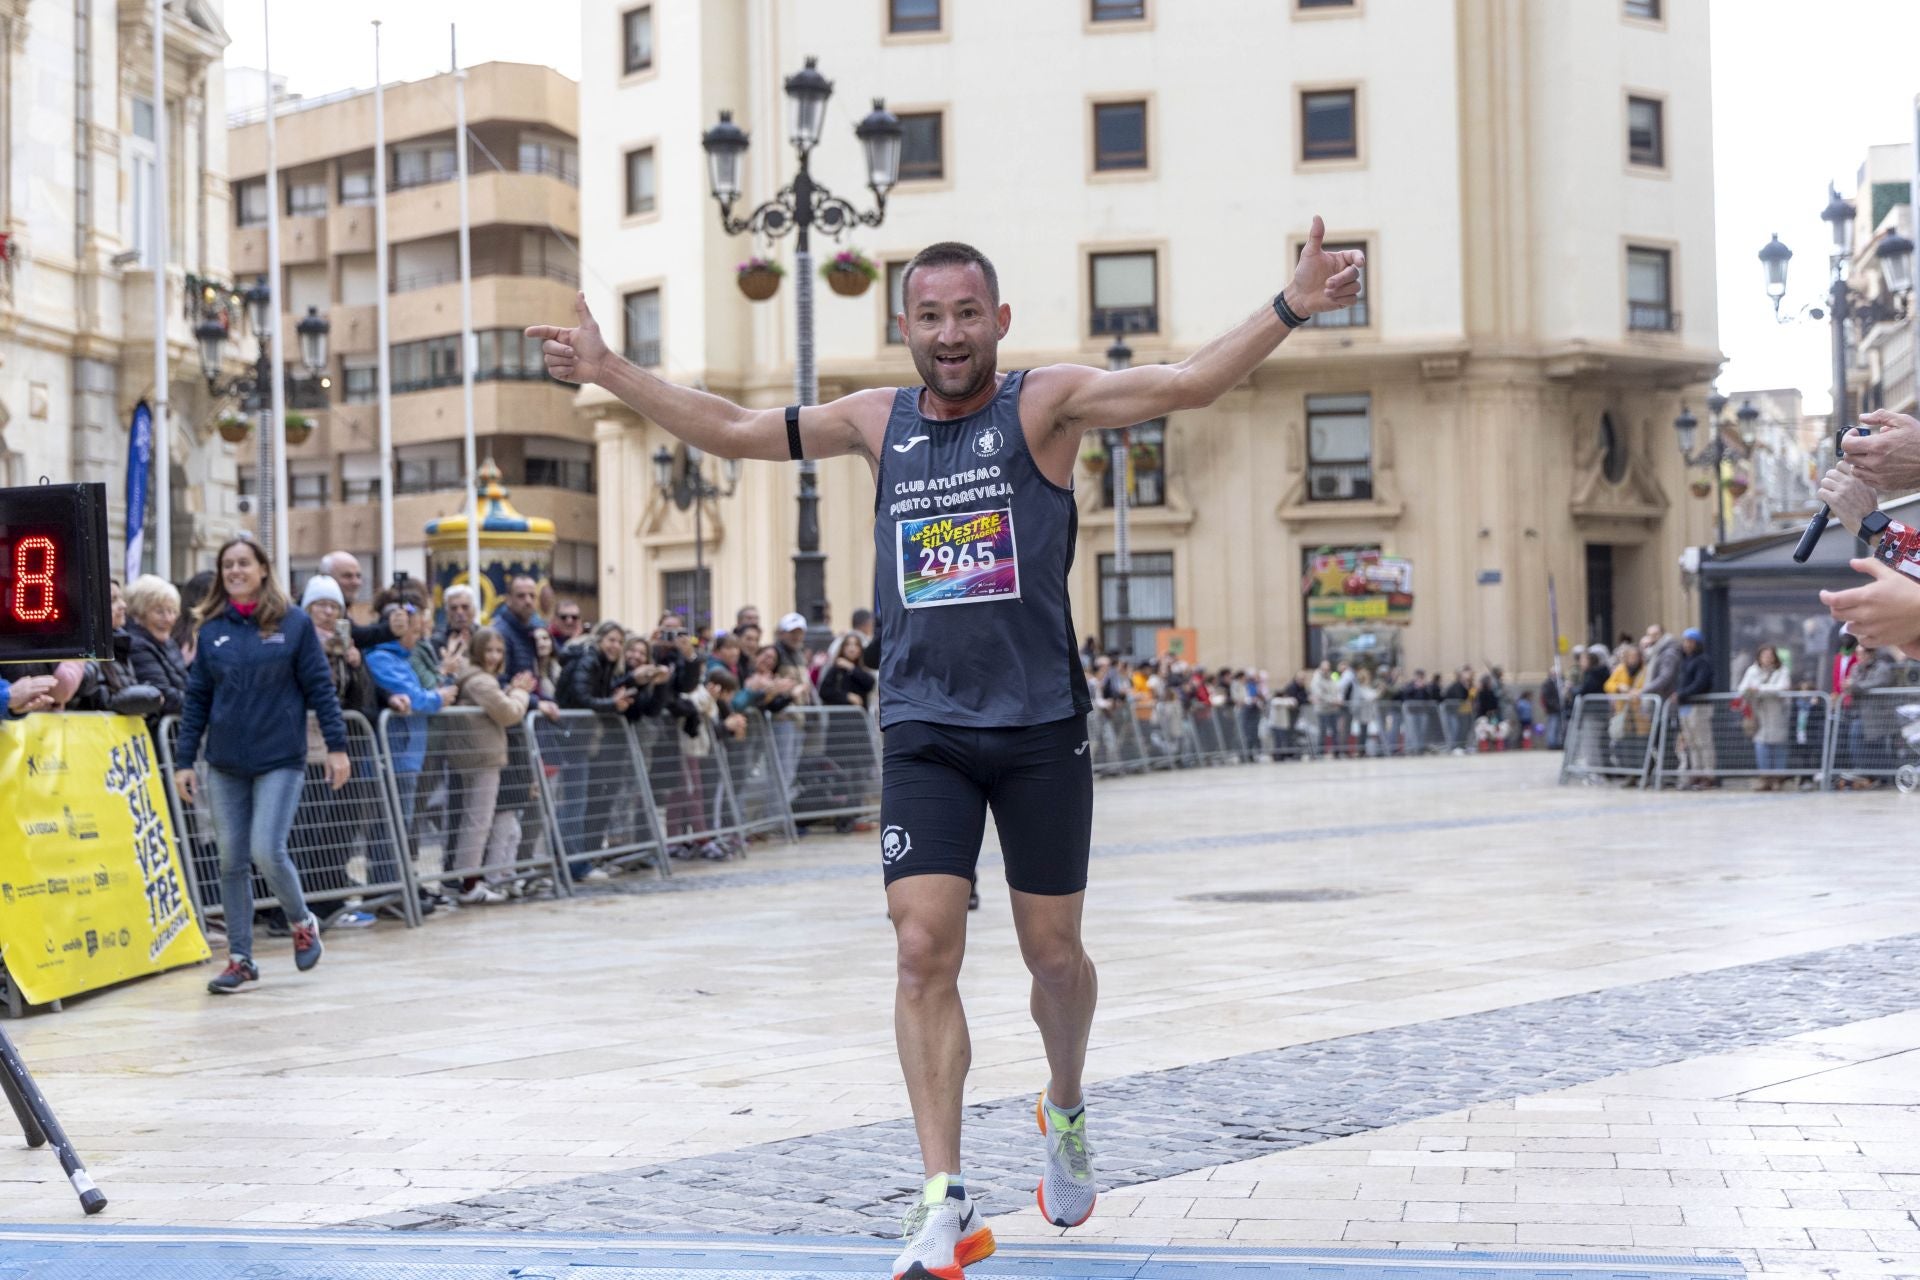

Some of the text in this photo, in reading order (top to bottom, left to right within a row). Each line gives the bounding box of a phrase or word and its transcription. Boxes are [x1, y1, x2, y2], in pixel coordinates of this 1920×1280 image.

[895, 465, 1001, 495] CLUB ATLETISMO
[890, 482, 1014, 516] PUERTO TORREVIEJA
[922, 519, 952, 539] SAN
[922, 513, 1000, 549] SILVESTRE
[955, 527, 1002, 546] CARTAGENA
[919, 541, 996, 577] 2965
[111, 733, 150, 790] SAN
[129, 783, 156, 835] SIL
[134, 819, 169, 881] VES
[145, 866, 182, 928] TRE
